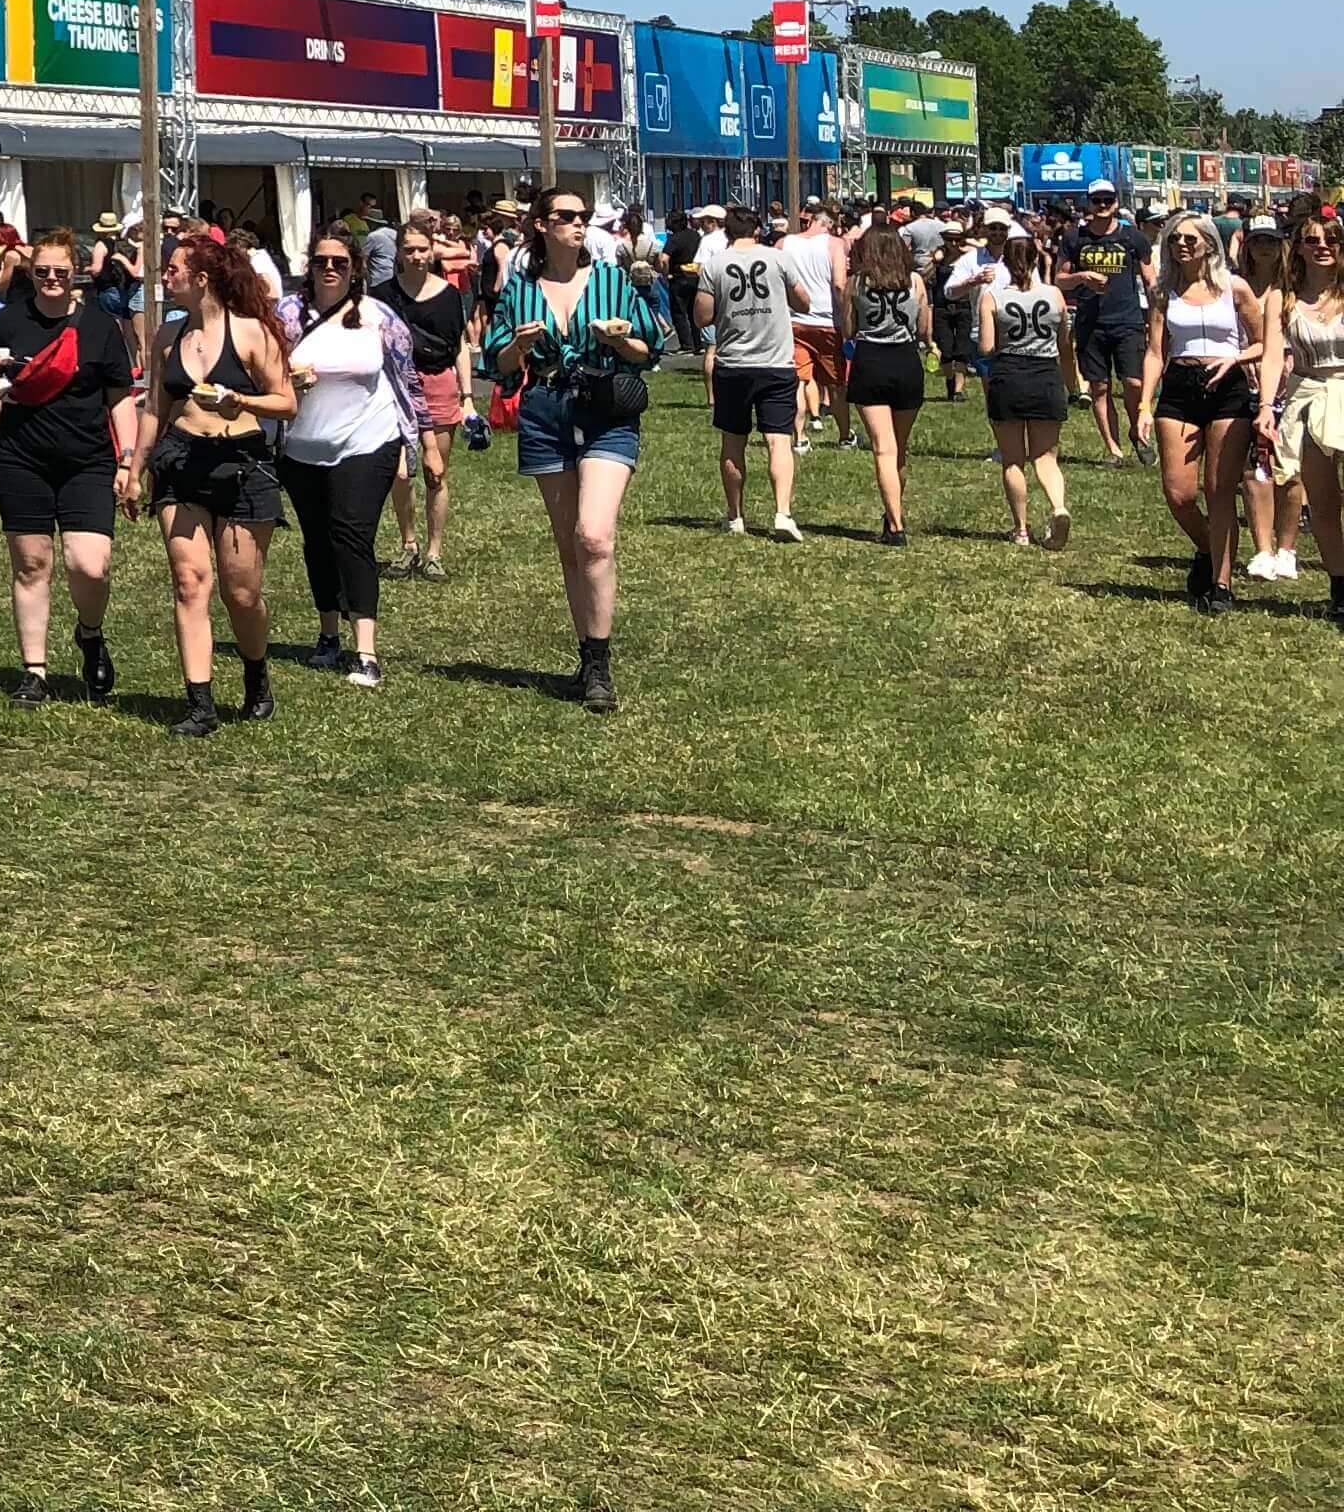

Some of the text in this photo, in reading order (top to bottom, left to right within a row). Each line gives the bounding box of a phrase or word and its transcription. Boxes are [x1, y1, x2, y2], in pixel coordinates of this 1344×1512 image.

[103, 2, 164, 32] BURGS
[536, 15, 560, 28] REST
[305, 38, 345, 63] DRINKS
[775, 44, 806, 57] REST
[720, 116, 740, 136] KBC
[818, 123, 836, 143] KBC
[1041, 170, 1083, 182] KBC
